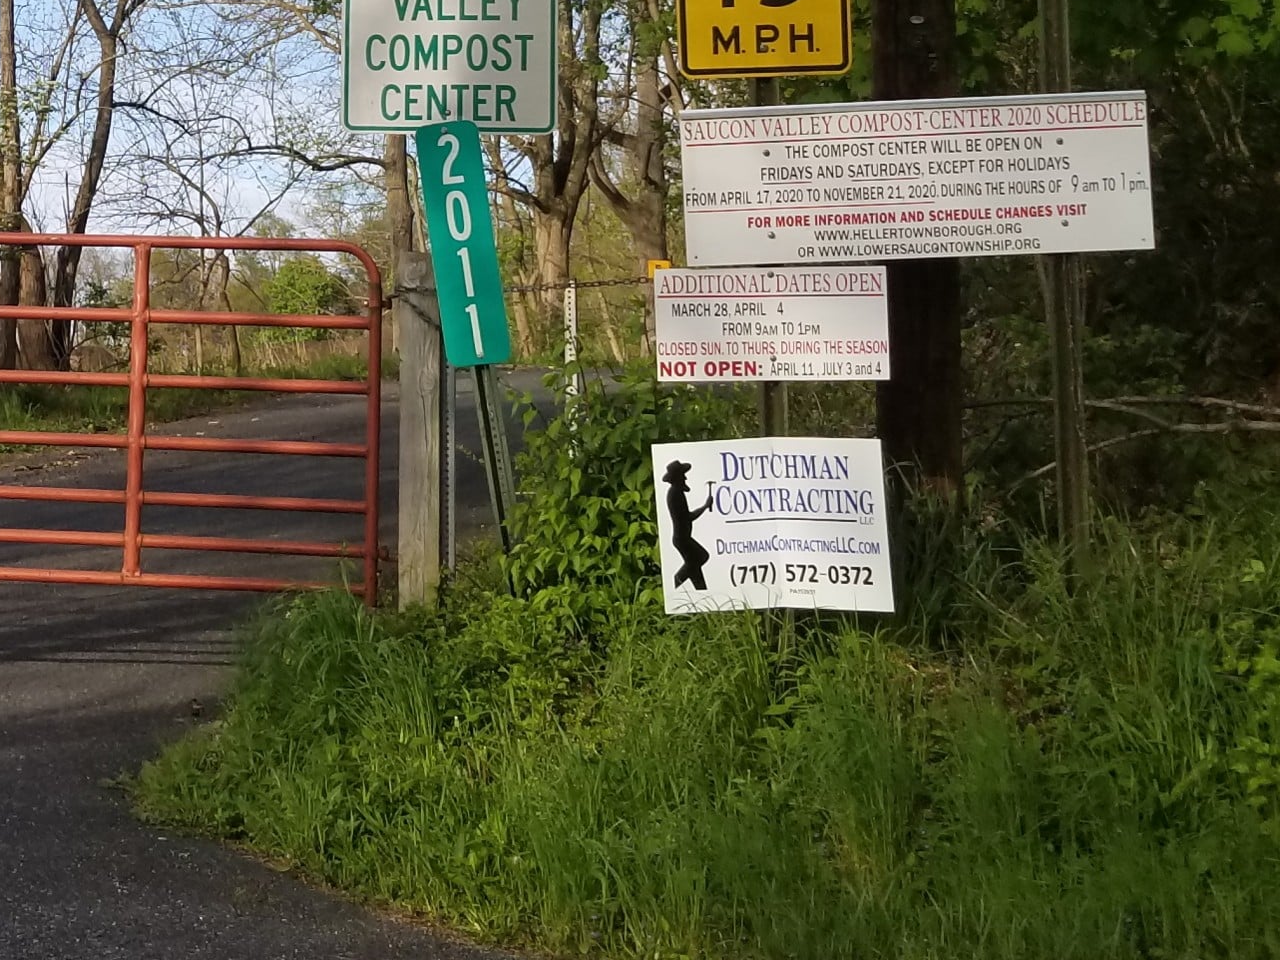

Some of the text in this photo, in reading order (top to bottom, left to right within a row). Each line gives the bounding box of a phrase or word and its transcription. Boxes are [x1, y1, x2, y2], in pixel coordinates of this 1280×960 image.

[365, 34, 534, 71] COMPOST
[381, 83, 516, 121] CENTER
[684, 119, 755, 141] SAUCON
[761, 115, 832, 137] VALLEY
[1008, 106, 1041, 126] 2020
[1047, 101, 1145, 124] SCHEDULE
[785, 136, 1042, 159] THE COMPOST CENTER WILL BE OPEN ON
[761, 156, 1070, 181] FRIDAYS AND SATURDAYS, EXCEPT FOR HOLIDAYS
[686, 193, 717, 207] FROM
[720, 192, 751, 205] APRIL
[756, 190, 772, 204] 17,
[776, 189, 803, 204] 2020
[808, 188, 820, 202] TO
[824, 186, 884, 202] NOVEMBER
[888, 185, 905, 200] 21,
[941, 182, 982, 198] DURING
[985, 182, 1004, 196] THE
[1008, 180, 1045, 195] HOURS
[1048, 179, 1062, 193] OF
[1071, 174, 1079, 193] 9
[1083, 182, 1099, 193] am
[1102, 177, 1115, 191] TO
[1120, 172, 1125, 190] 1
[747, 204, 1087, 229] FOR MORE INFORMATION AND SCHEDULE CHANGES VISIT
[814, 223, 1022, 241] WWW.HELLERTOWNBOROUGH.ORG
[437, 133, 484, 359] 2011
[798, 238, 1040, 258] OR WWW.LOWERSAUCONTOWNSHIP.ORG
[660, 272, 883, 294] ADDITIONAL DATES OPEN
[672, 302, 784, 317] MARCH 28, APRIL 4
[722, 322, 820, 336] FROM 9AM TO 1PM
[658, 340, 888, 356] CLOSED SUN. TO THURS. DURING THE SEASON
[660, 361, 697, 377] NOT
[703, 360, 763, 377] OPEN:
[770, 362, 798, 376] APRIL
[822, 362, 843, 375] JULY
[846, 362, 852, 375] 3
[855, 361, 872, 375] and
[875, 361, 882, 375] 4
[719, 451, 849, 482] DUTCHMAN
[715, 485, 874, 516] CONTRACTING
[860, 516, 874, 525] LLC
[730, 561, 874, 587] (717) 572-0372
